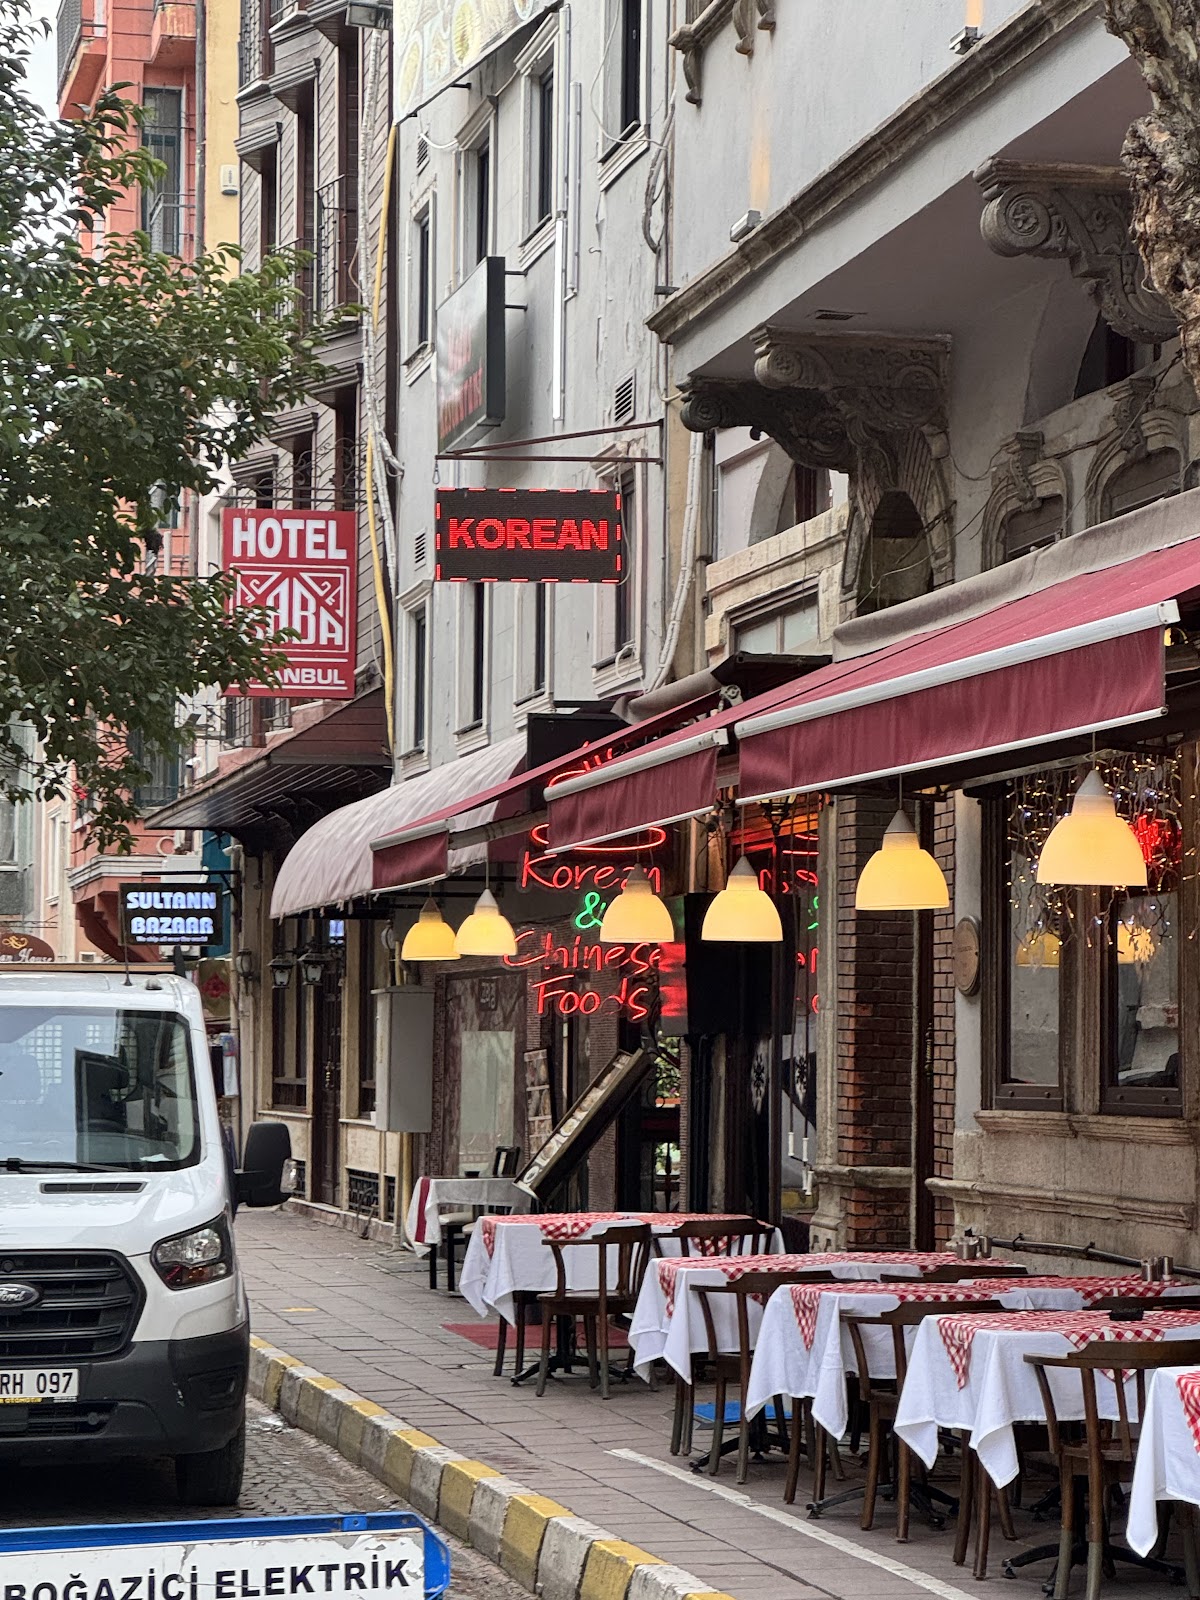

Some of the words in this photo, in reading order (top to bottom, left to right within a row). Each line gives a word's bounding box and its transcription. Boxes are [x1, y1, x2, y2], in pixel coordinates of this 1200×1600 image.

[232, 517, 348, 560] HOTEL
[449, 518, 608, 550] KOREAN
[239, 577, 344, 645] ABA
[126, 891, 217, 910] SULTANN
[575, 892, 606, 929] &
[130, 916, 214, 935] BAZAAR
[531, 974, 649, 1021] Foods
[36, 1372, 73, 1394] 097
[215, 1554, 411, 1599] ELEKTRİK
